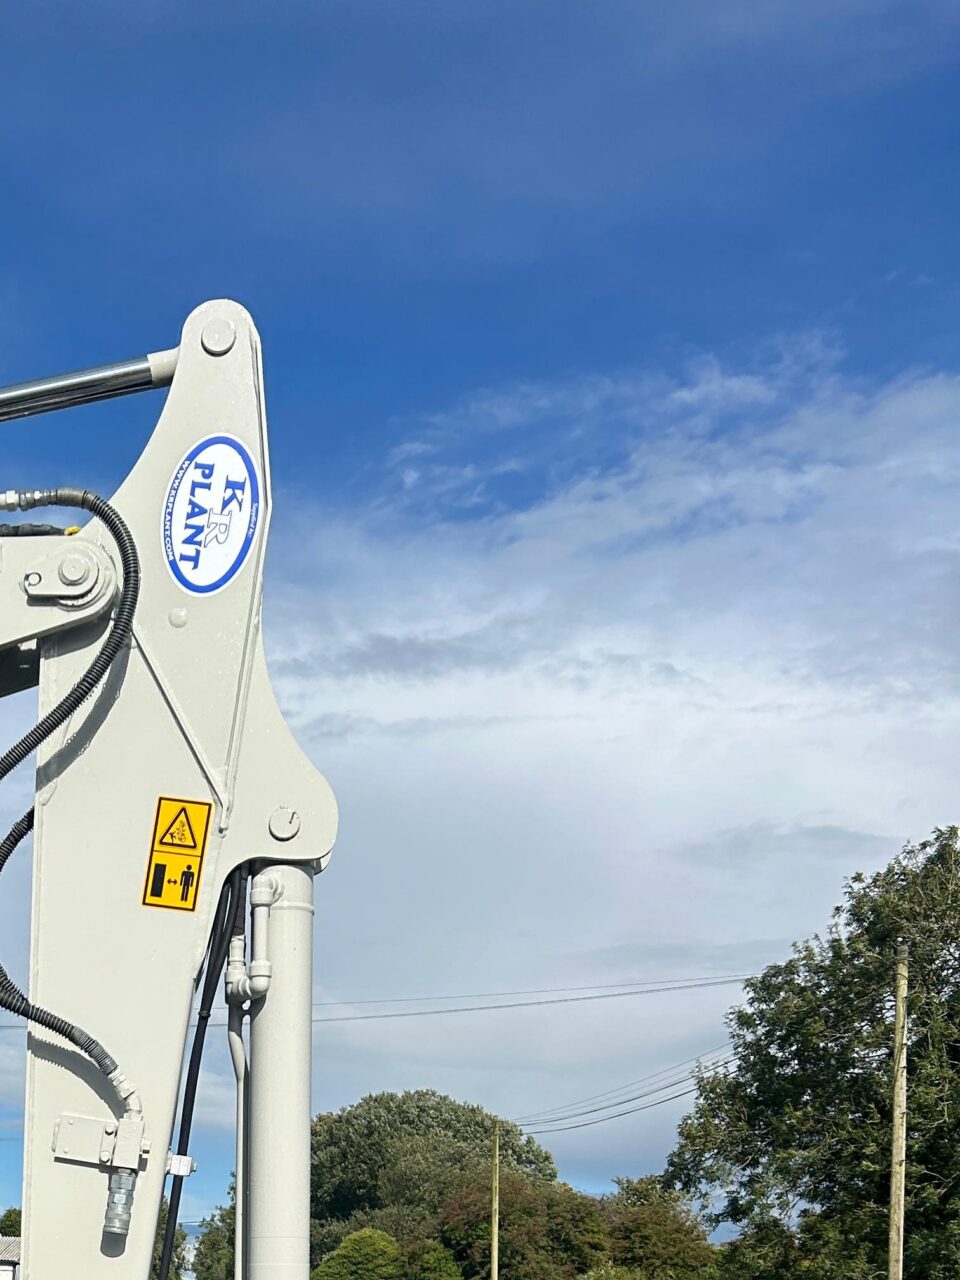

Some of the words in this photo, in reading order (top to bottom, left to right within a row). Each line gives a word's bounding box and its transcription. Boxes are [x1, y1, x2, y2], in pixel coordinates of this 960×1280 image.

[164, 460, 190, 561] WWW.KRPLANT.COM
[179, 462, 215, 570] PLANT
[203, 475, 247, 548] KR
